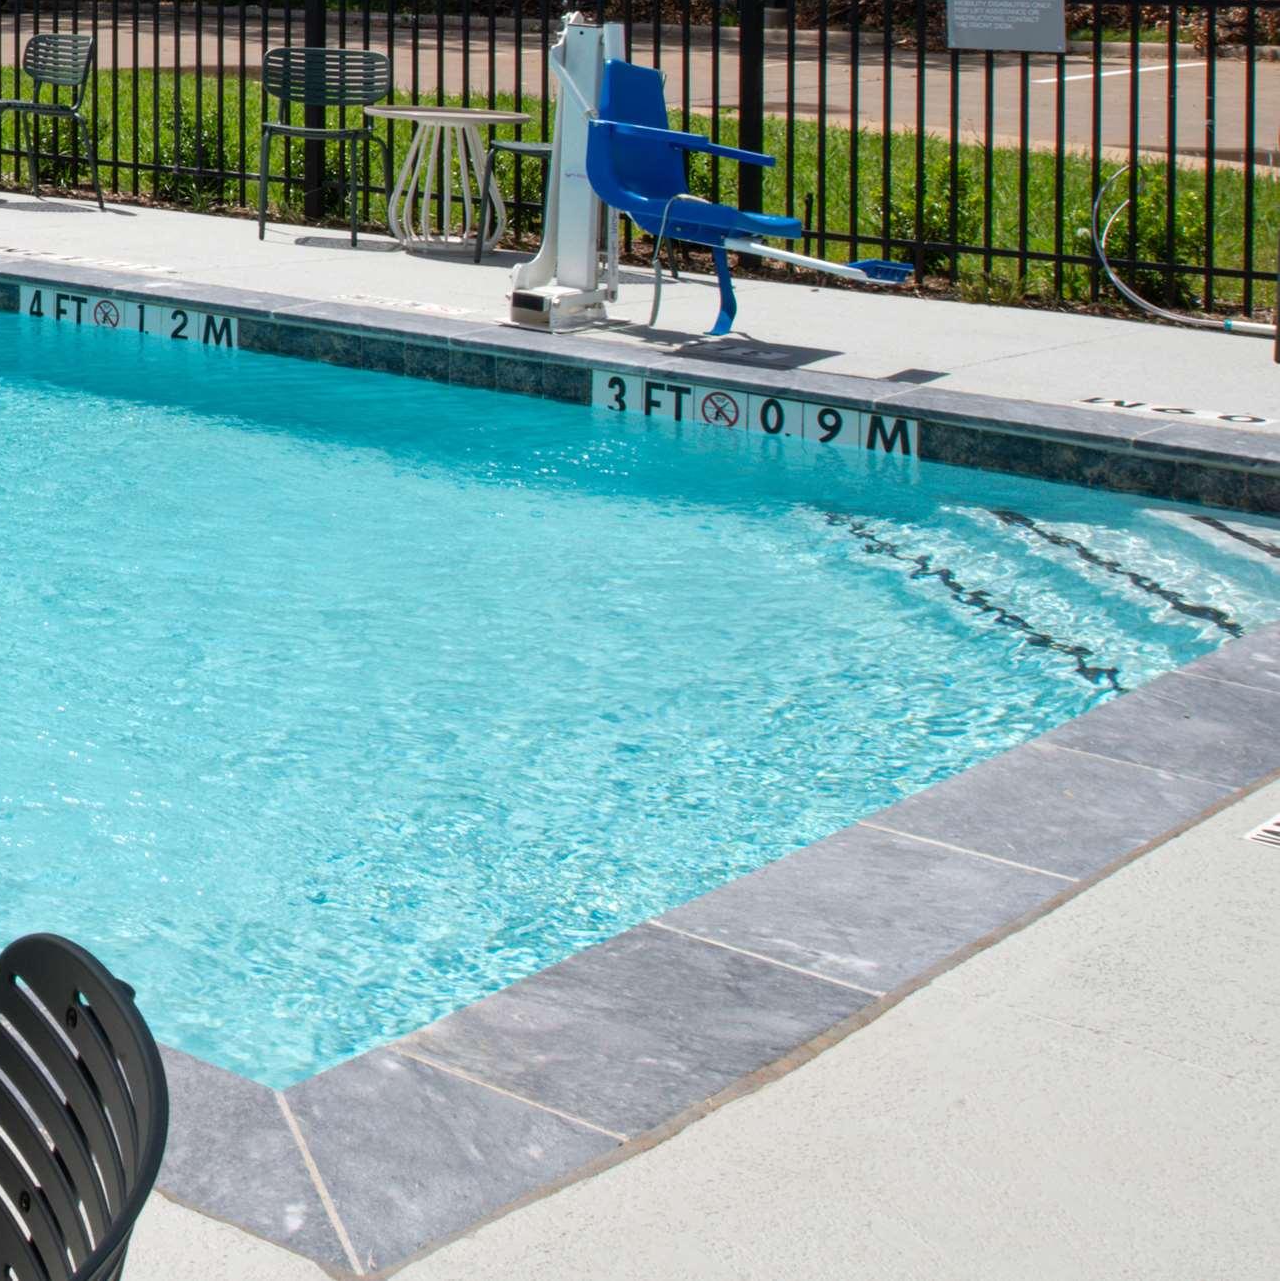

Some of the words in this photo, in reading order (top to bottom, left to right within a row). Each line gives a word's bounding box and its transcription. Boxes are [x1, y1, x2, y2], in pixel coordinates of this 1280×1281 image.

[55, 293, 88, 324] FT
[202, 315, 234, 348] M
[607, 377, 626, 411] 3
[644, 381, 692, 421] FT
[866, 415, 912, 457] M
